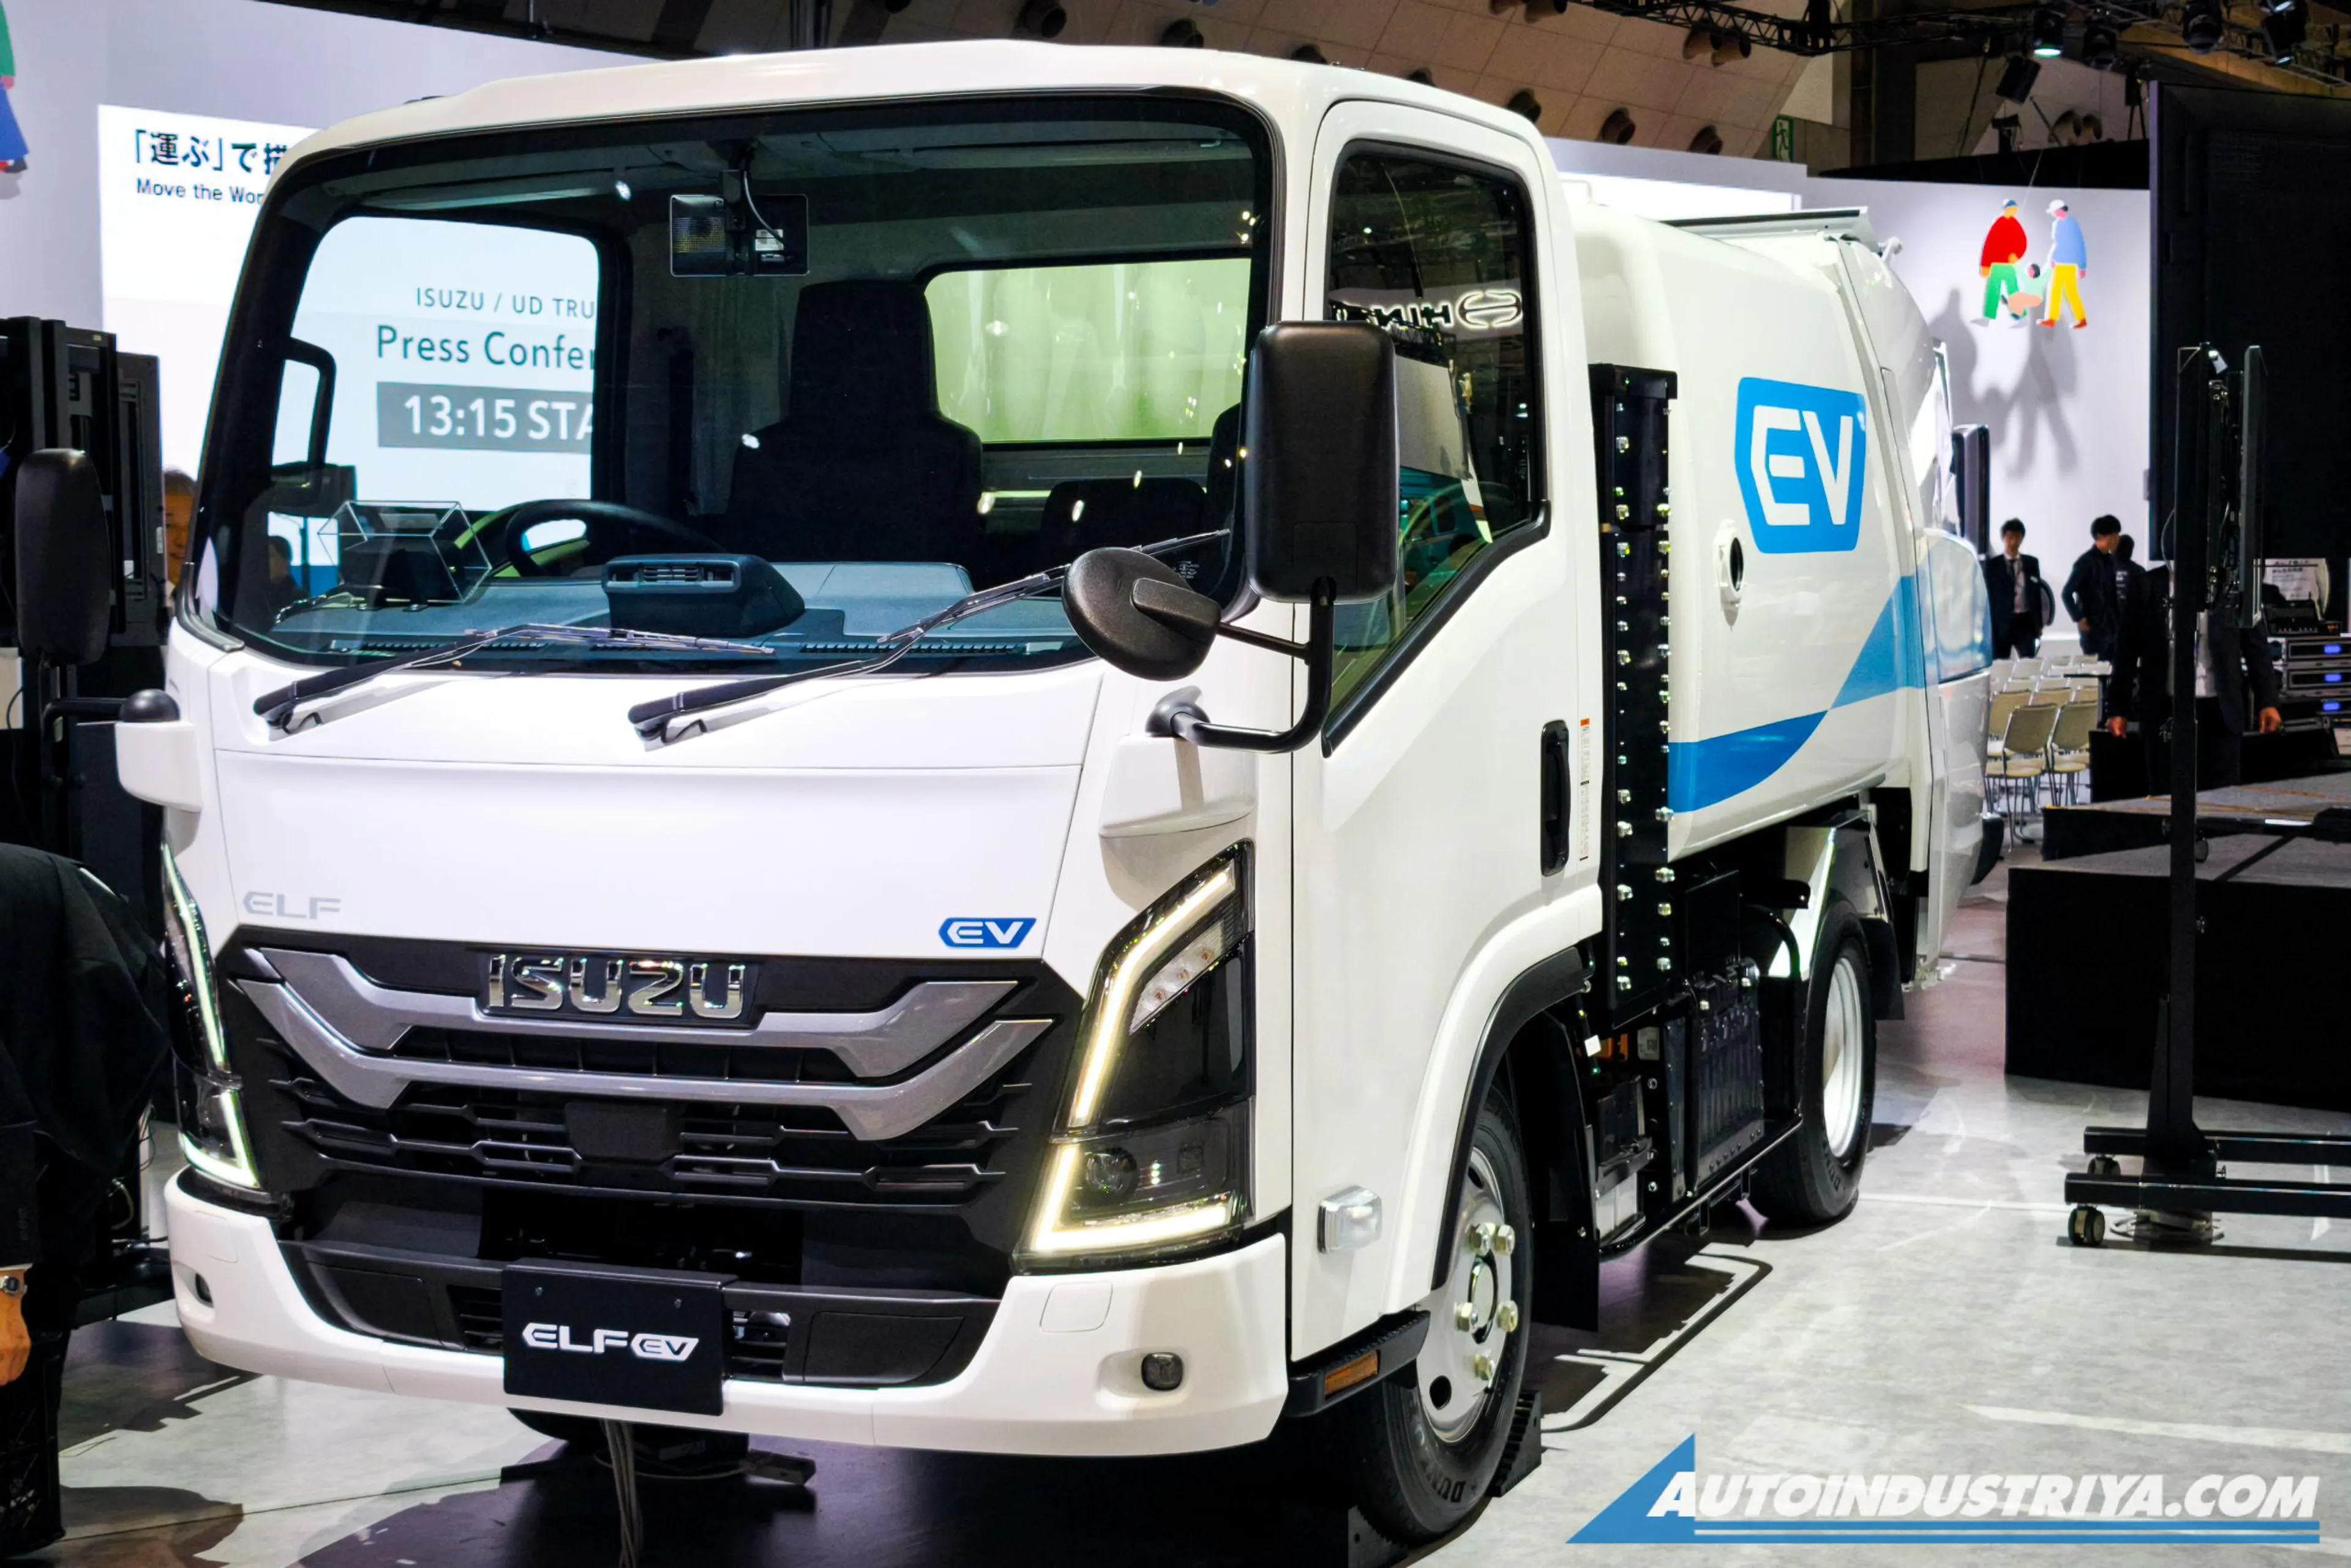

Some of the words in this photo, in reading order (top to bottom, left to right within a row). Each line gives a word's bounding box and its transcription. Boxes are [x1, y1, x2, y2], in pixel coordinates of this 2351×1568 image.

[137, 178, 186, 198] Move
[193, 184, 223, 201] the
[417, 287, 485, 311] ISUZU
[512, 294, 543, 315] UD
[552, 298, 595, 320] TRU
[377, 324, 470, 364] Press
[404, 395, 517, 438] 13:15
[1750, 404, 1854, 527] EV
[242, 891, 341, 920] ELF
[947, 920, 1025, 945] EV
[489, 953, 746, 1019] ISUZU
[522, 1322, 629, 1354] ELF
